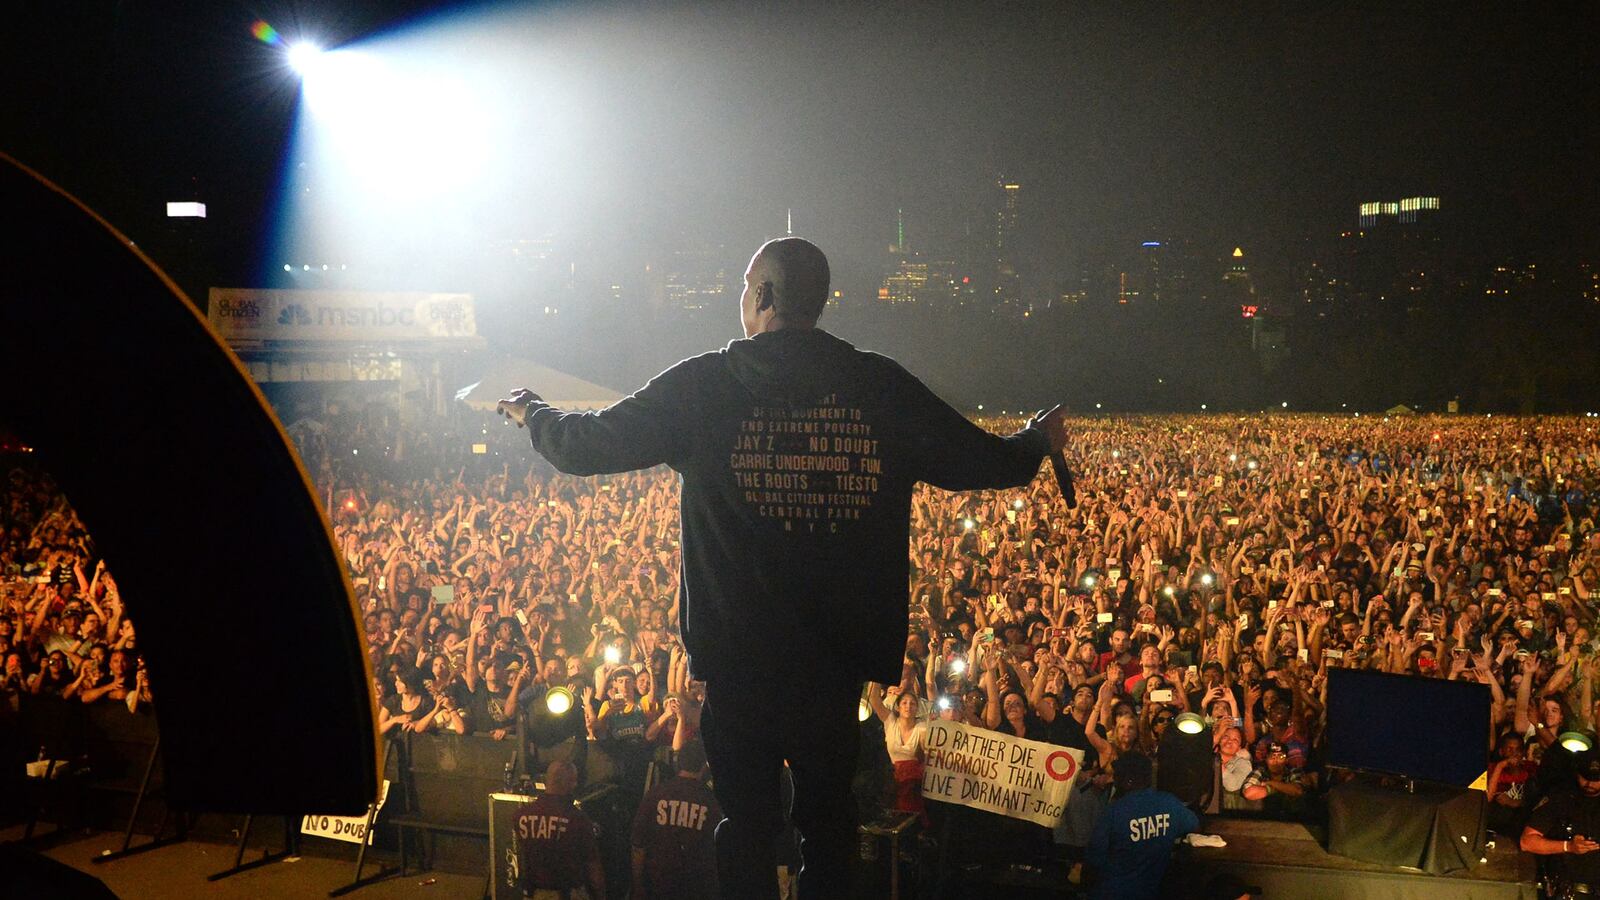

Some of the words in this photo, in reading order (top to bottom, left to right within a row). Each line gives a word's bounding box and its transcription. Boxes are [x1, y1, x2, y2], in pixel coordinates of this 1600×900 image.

[318, 302, 414, 326] msnbc
[850, 409, 862, 421] TO
[741, 421, 763, 433] END
[769, 421, 820, 433] EXTREME
[824, 423, 872, 436] POVERTY
[735, 436, 763, 451] JAY
[767, 436, 775, 451] Z
[809, 436, 829, 452] NO
[834, 437, 879, 455] DOUBT
[730, 453, 774, 470] CARRIE
[776, 455, 849, 472] UNDERWOOD
[735, 472, 761, 488] THE
[765, 474, 809, 490] ROOTS
[787, 492, 825, 505] CITIZEN
[828, 494, 873, 506] FESTIVAL
[759, 505, 820, 519] CENTRAL
[827, 508, 860, 520] PARK
[952, 730, 1007, 762] RATHER
[1010, 744, 1037, 769] DIE
[926, 748, 999, 780] ENORMOUS
[1007, 764, 1046, 791] THAN
[922, 771, 956, 797] LIVE
[656, 799, 708, 830] STAFF
[305, 815, 329, 831] NO
[333, 819, 365, 839] DOUB
[519, 815, 569, 840] STAFF
[1129, 813, 1170, 842] STAFF
